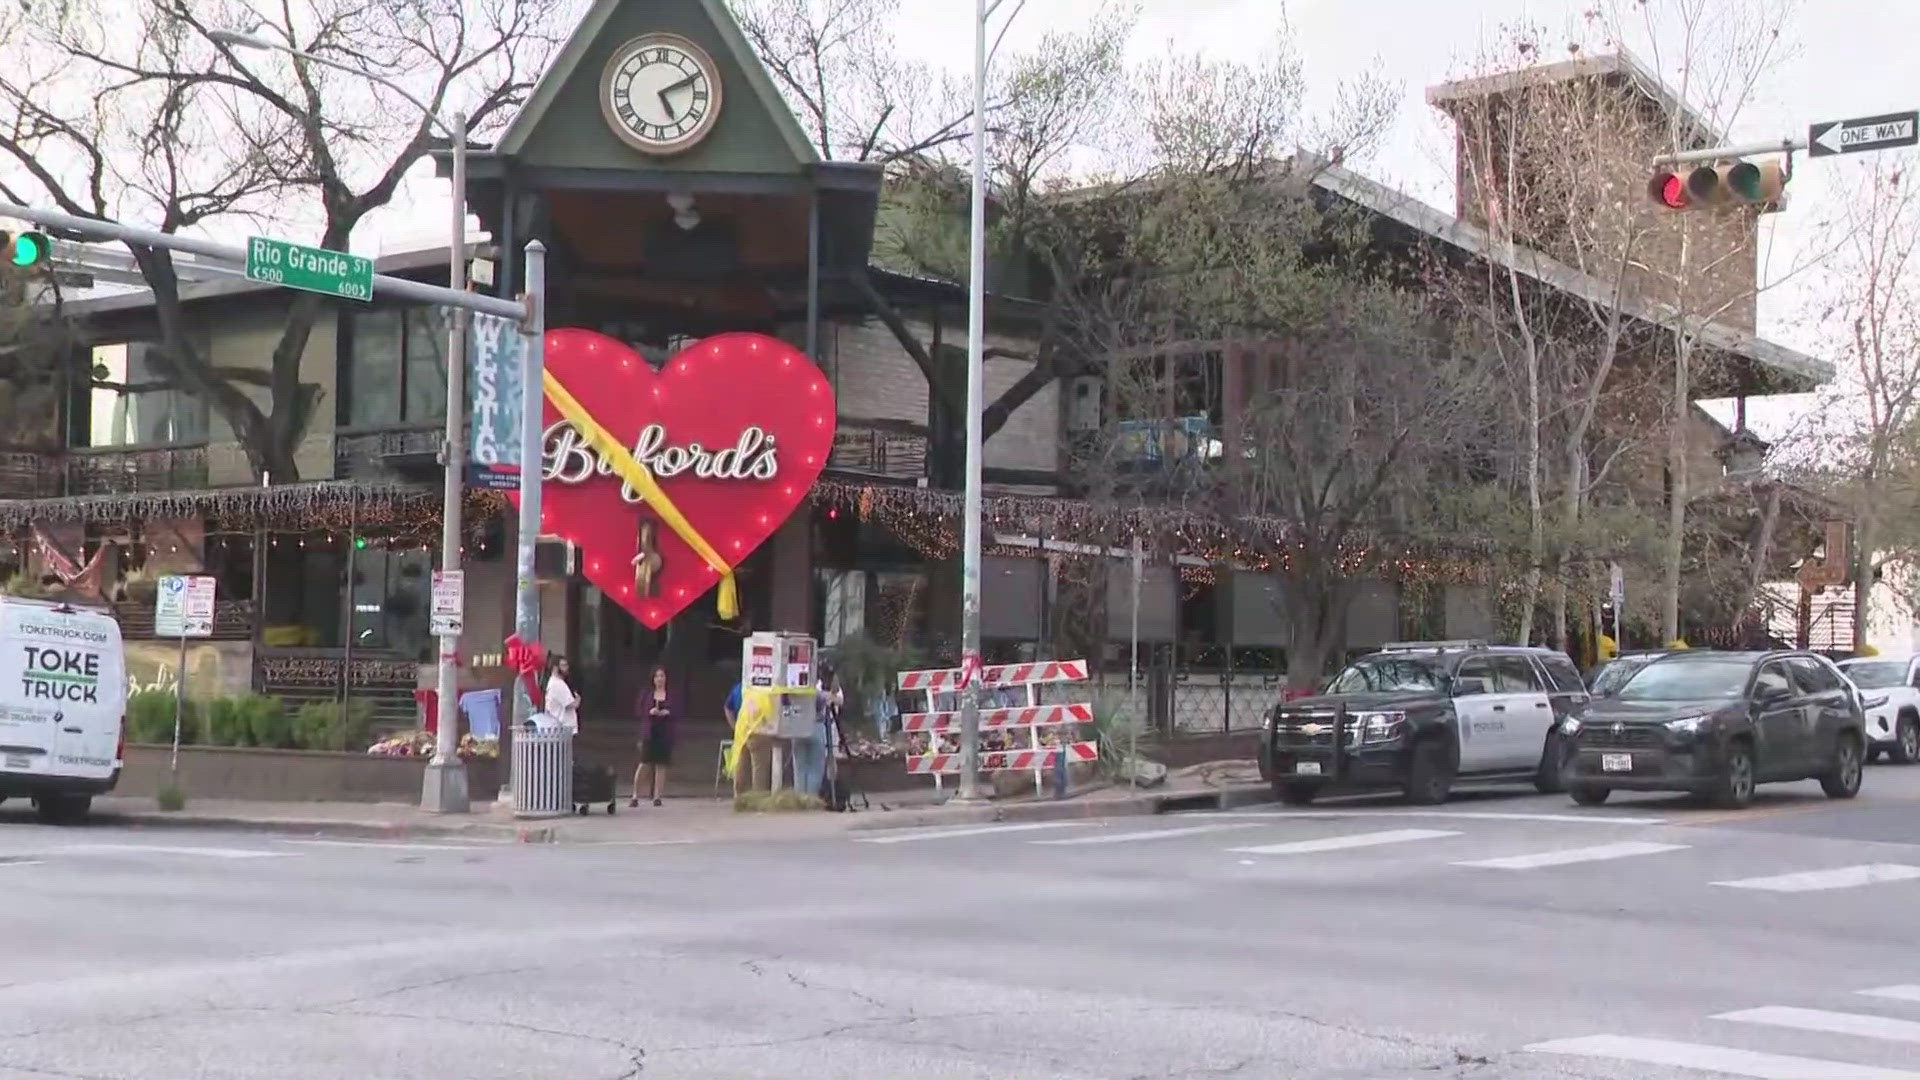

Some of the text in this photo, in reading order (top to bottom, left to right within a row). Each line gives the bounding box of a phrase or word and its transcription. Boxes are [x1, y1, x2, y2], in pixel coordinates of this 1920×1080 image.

[1840, 122, 1906, 144] ONE WAY
[253, 240, 368, 277] Rio Grande ST
[261, 266, 284, 282] 500
[338, 280, 359, 296] 600
[24, 646, 99, 676] TOKE
[22, 679, 97, 704] TRUCK
